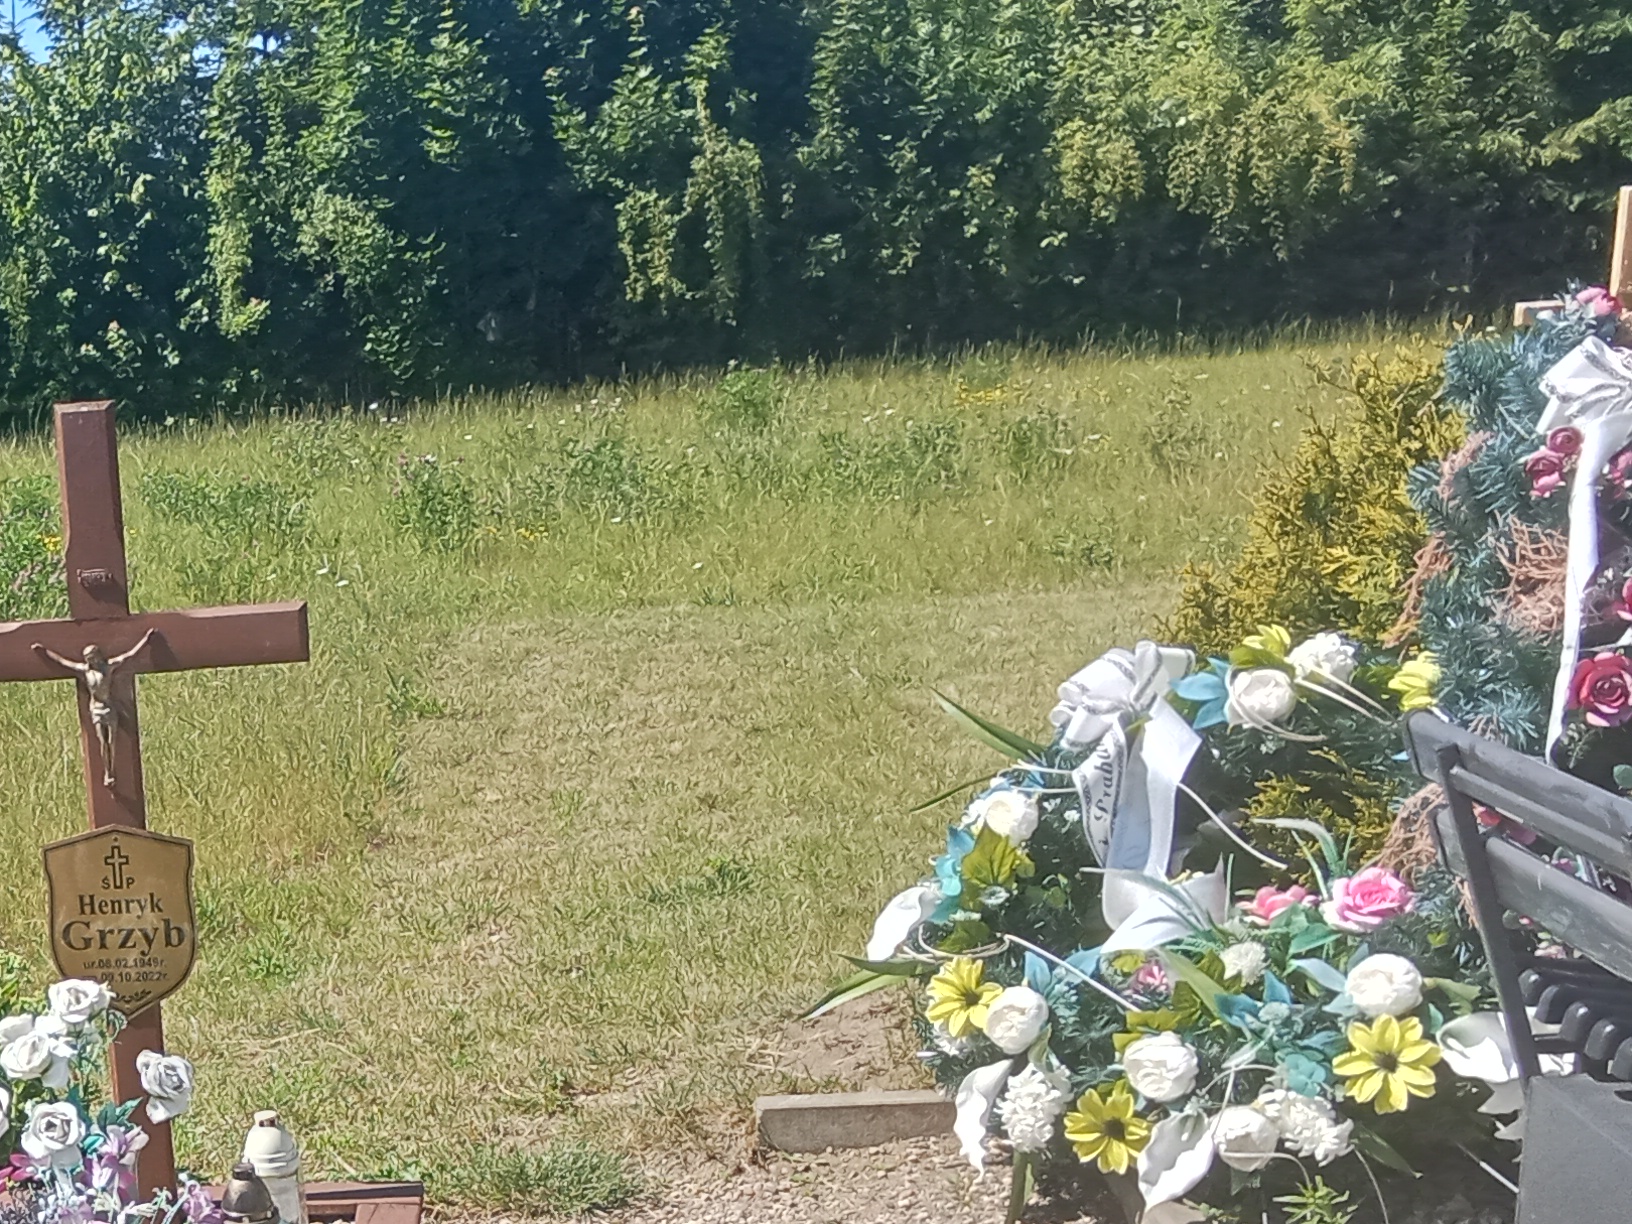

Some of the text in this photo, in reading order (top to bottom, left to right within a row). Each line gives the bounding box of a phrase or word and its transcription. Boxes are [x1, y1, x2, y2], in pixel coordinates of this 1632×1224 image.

[126, 877, 136, 890] P
[77, 892, 164, 919] Henryk
[61, 918, 186, 957] Grzyb
